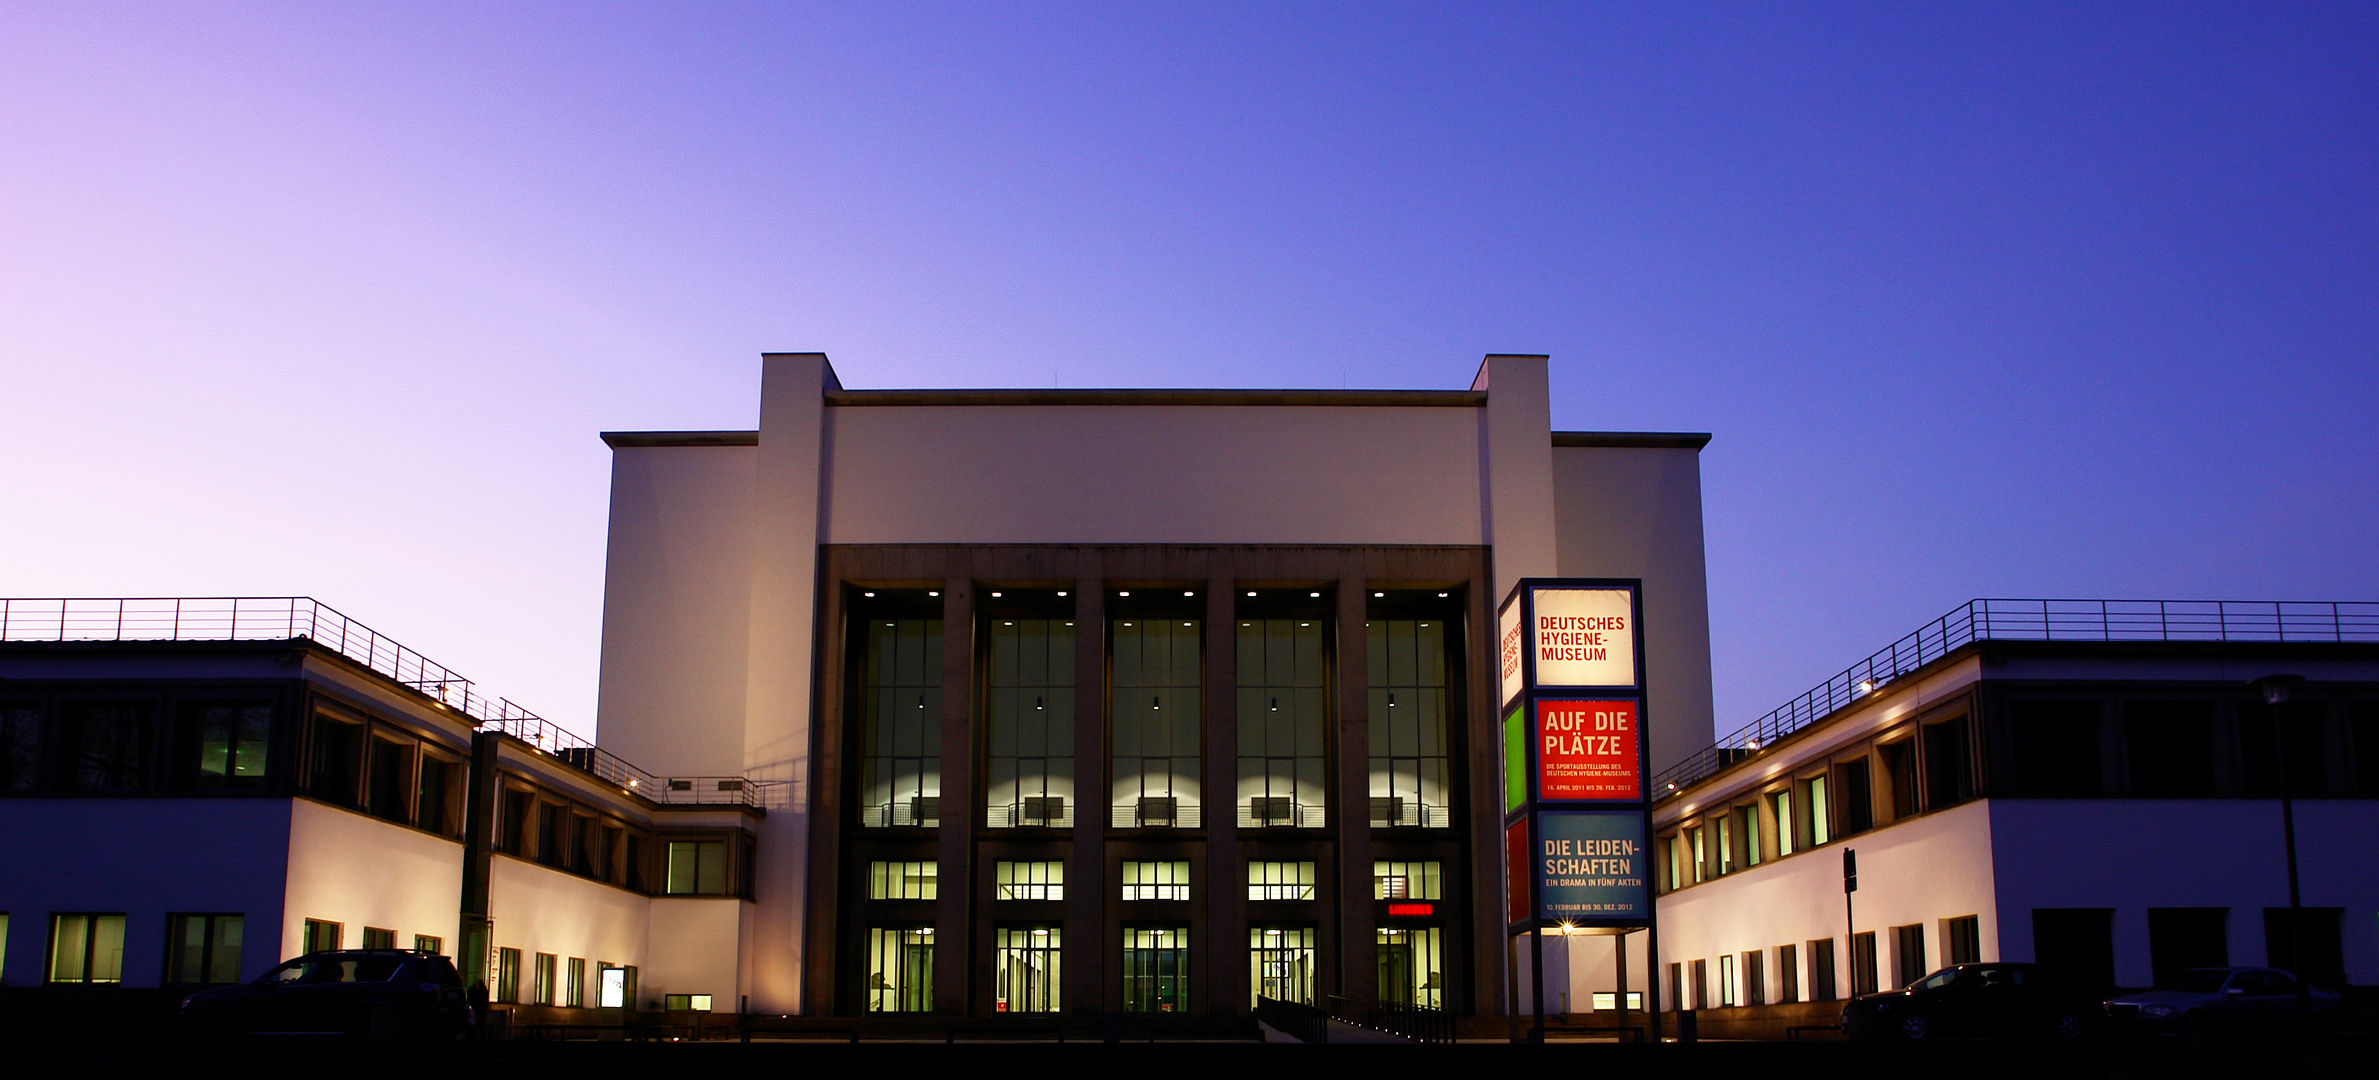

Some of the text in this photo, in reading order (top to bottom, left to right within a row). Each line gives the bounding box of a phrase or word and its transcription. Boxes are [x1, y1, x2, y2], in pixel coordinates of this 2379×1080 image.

[1540, 616, 1625, 630] DEUTSCHES
[1541, 632, 1608, 645] HYGIENE-
[1541, 647, 1607, 661] MUSEUM
[1545, 711, 1628, 731] AUF DIE
[1545, 732, 1622, 755] PLÄTZE
[1545, 839, 1640, 856] DIE LEIDEN-
[1545, 858, 1631, 875] SCHAFTEN
[1545, 877, 1642, 887] EIN DRAMA IN FÜNF AKTEN
